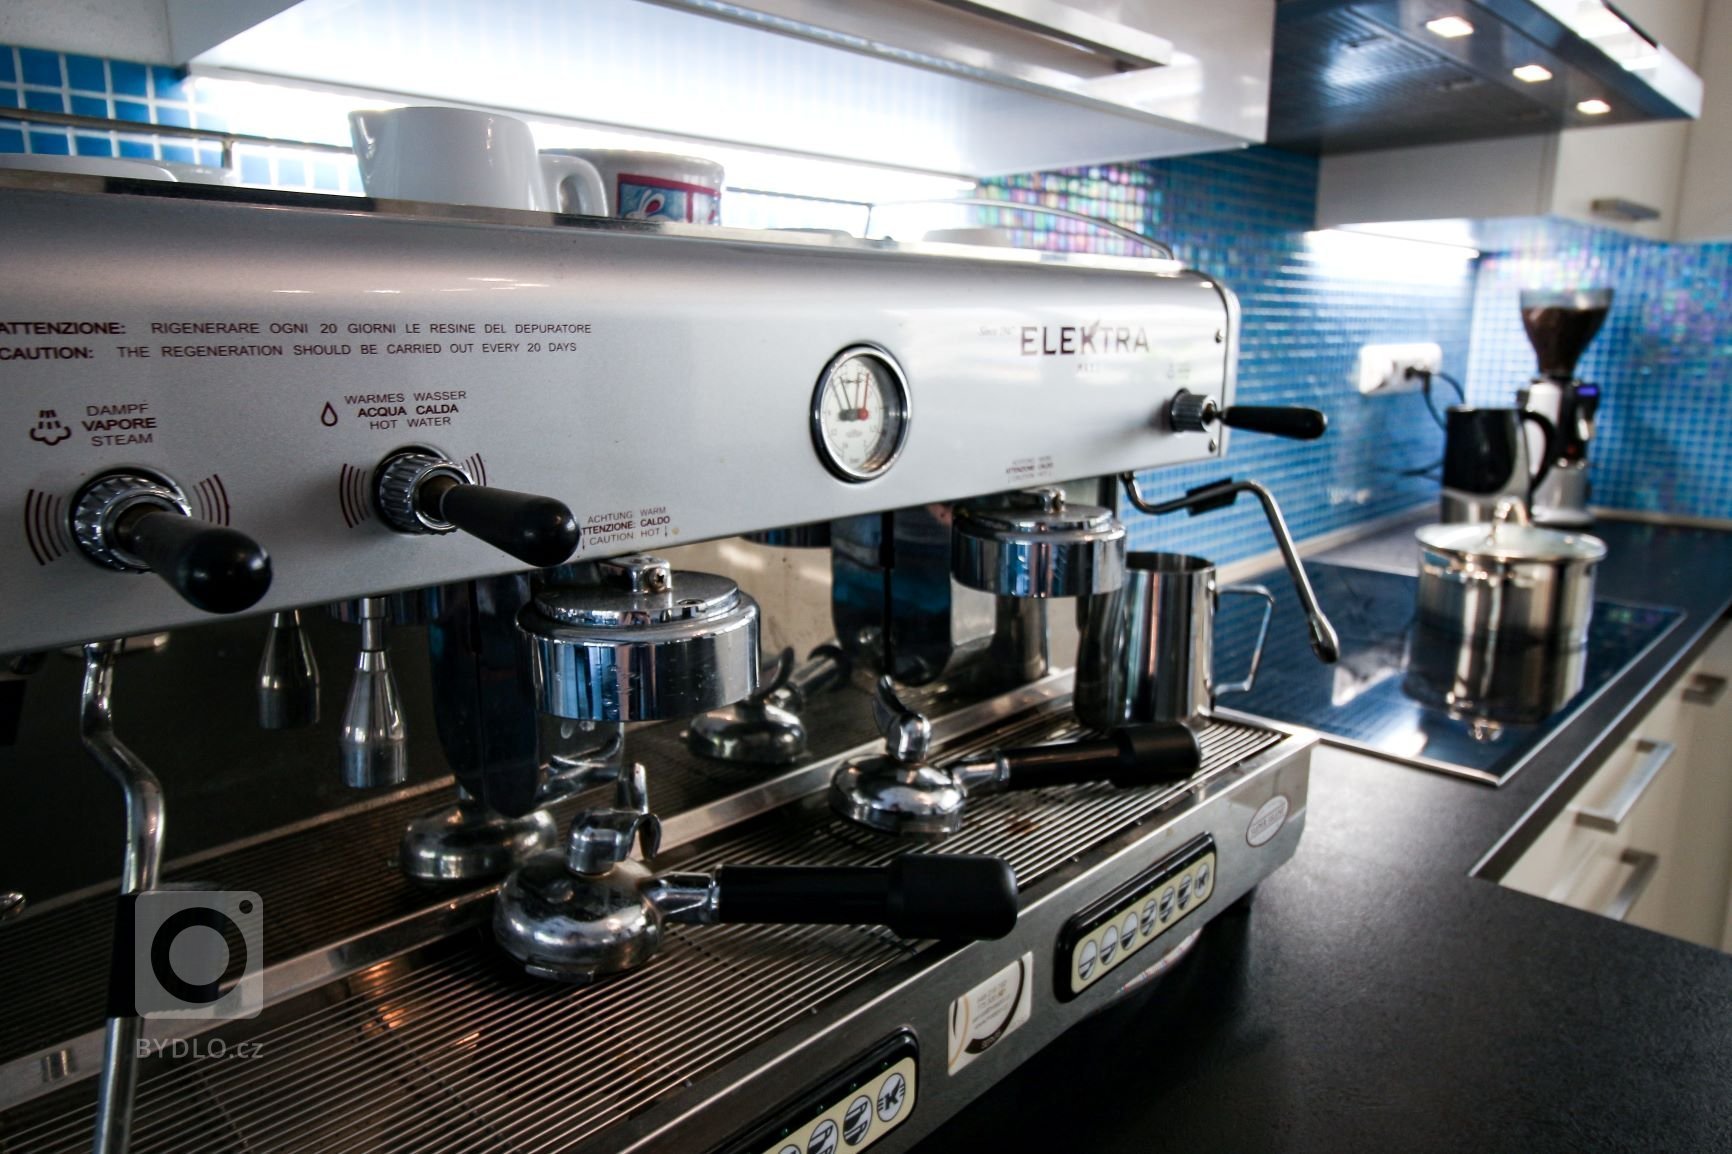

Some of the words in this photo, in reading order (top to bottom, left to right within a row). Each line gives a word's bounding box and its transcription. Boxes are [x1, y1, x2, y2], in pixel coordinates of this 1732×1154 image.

[0, 322, 126, 335] ATTENZIONE:
[152, 323, 260, 334] RIGENERARE
[270, 323, 309, 334] OGNI
[320, 323, 337, 334] 20
[347, 323, 396, 334] GIORNI
[406, 323, 421, 334] LE
[430, 323, 476, 334] RESINE
[484, 323, 506, 334] DEL
[515, 324, 592, 334] DEPURATORE
[1020, 320, 1150, 355] ELEKTRA
[0, 347, 93, 360] CAUTION:
[117, 346, 150, 358] THE
[162, 345, 283, 357] REGENERATION
[293, 344, 351, 356] SHOULD
[361, 344, 377, 355] BE
[387, 343, 442, 354] CARRIED
[450, 343, 474, 354] OUT
[482, 343, 520, 353] EVERY
[528, 343, 541, 353] 20
[549, 342, 577, 352] DAYS
[344, 393, 405, 405] WARMES
[413, 390, 467, 402] WASSER
[86, 403, 149, 417] DAMPF
[357, 404, 407, 418] ACQUA
[416, 402, 459, 415] CALDA
[82, 417, 157, 432] VAPORE
[370, 419, 397, 430] HOT
[407, 416, 451, 428] WATER
[91, 433, 153, 447] STEAM
[640, 507, 666, 517] WARM
[640, 515, 670, 528] CALDO
[640, 527, 660, 537] HOT
